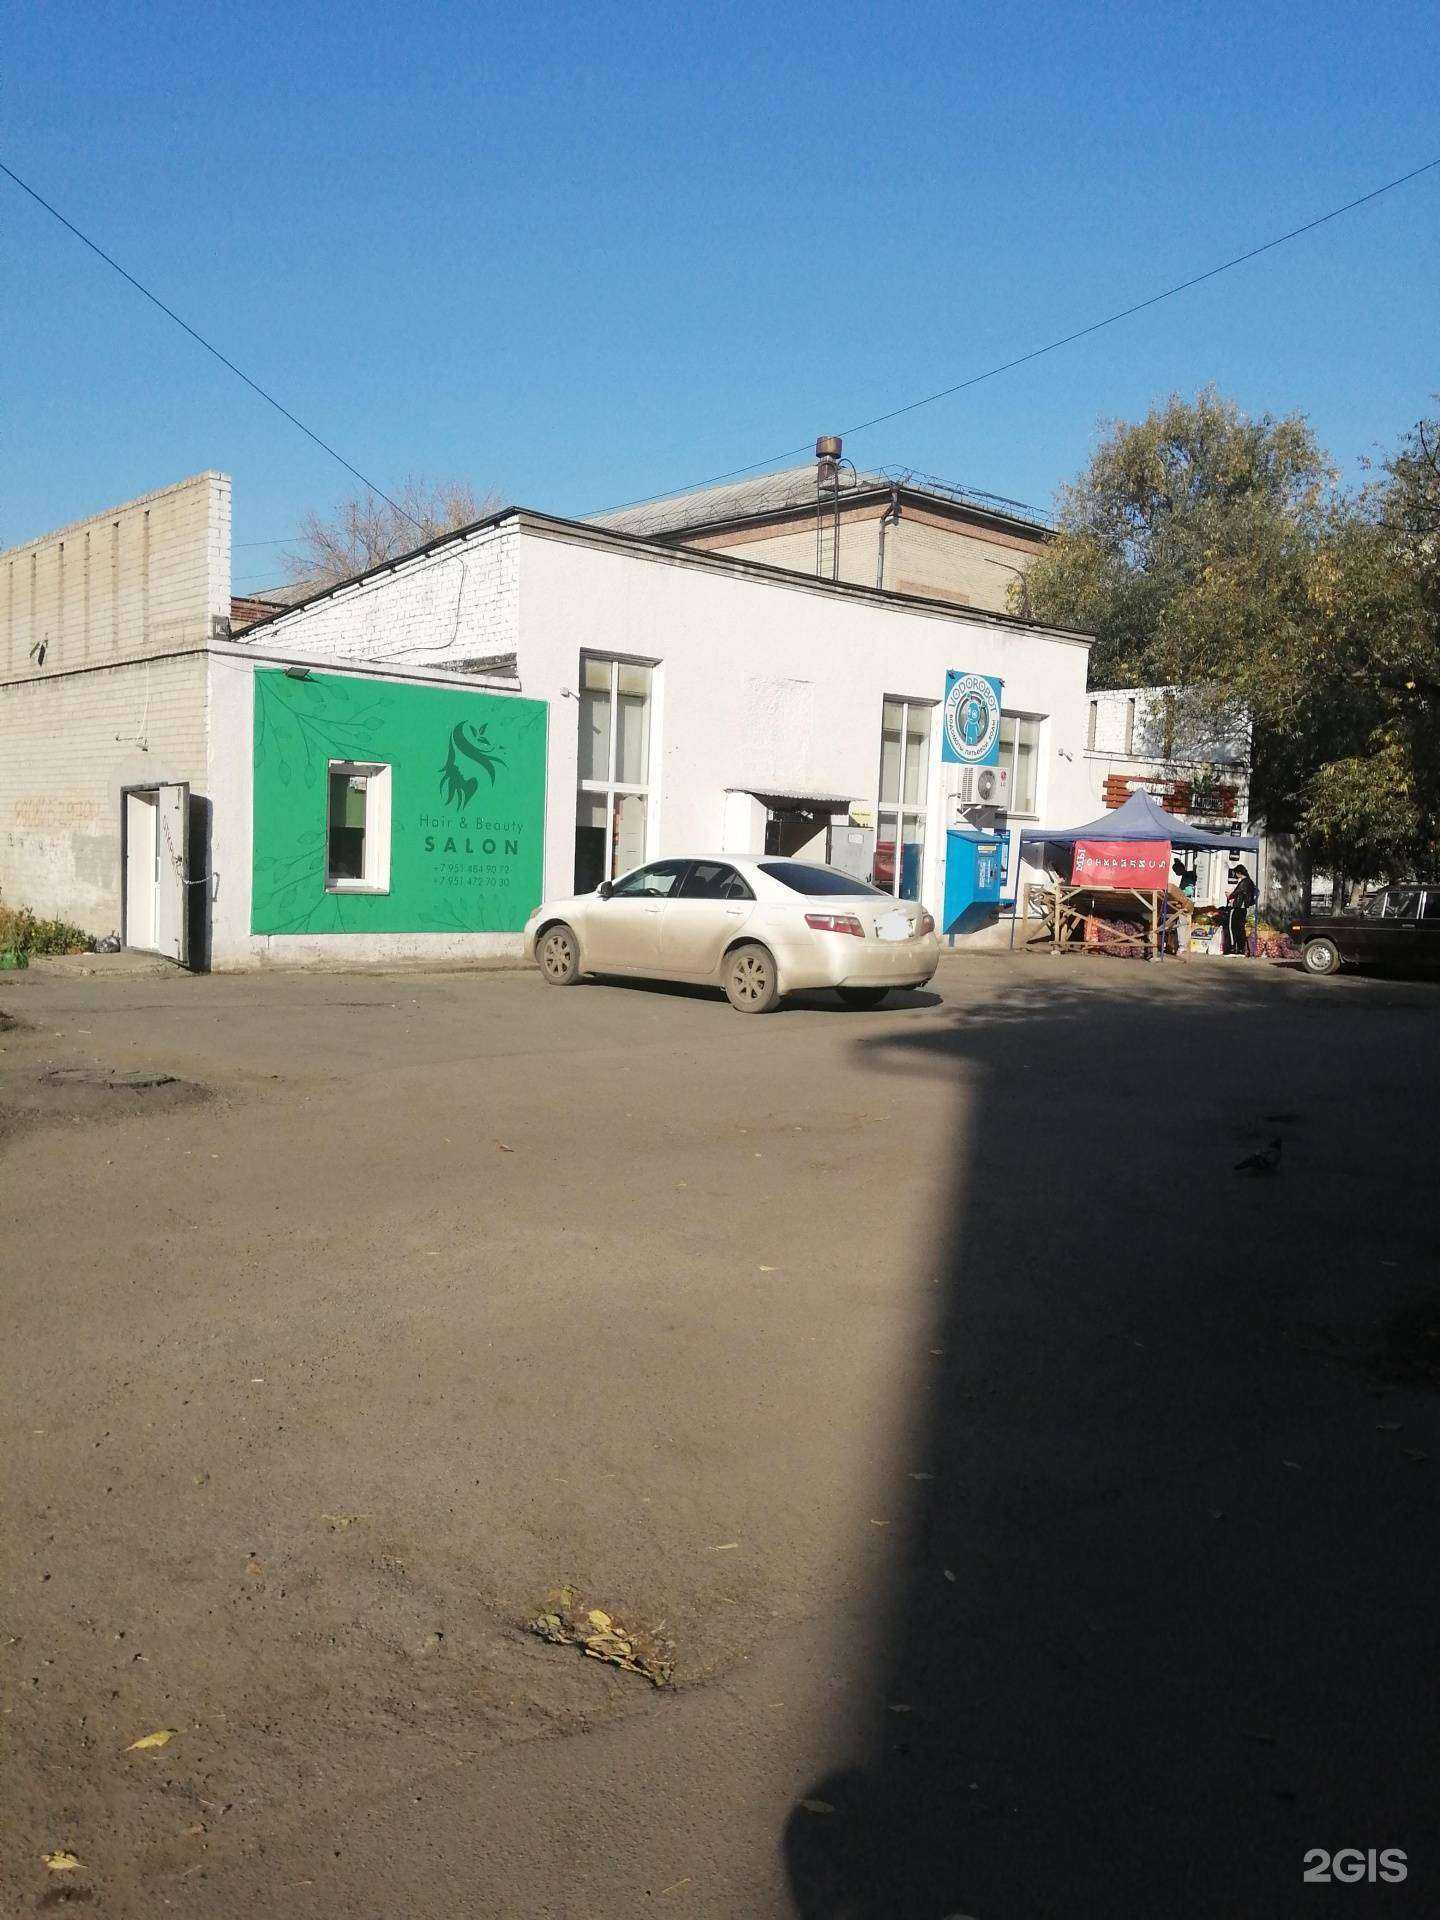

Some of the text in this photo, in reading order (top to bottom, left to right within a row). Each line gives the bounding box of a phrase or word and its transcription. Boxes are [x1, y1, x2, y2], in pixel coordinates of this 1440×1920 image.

[948, 677, 997, 712] VODOROBOT
[419, 814, 524, 835] Hair & Beauty
[424, 836, 519, 855] SALON
[448, 863, 464, 873] 951
[1076, 848, 1166, 872] МЫ ОТКРЫЛИСЬ
[448, 876, 464, 887] 951
